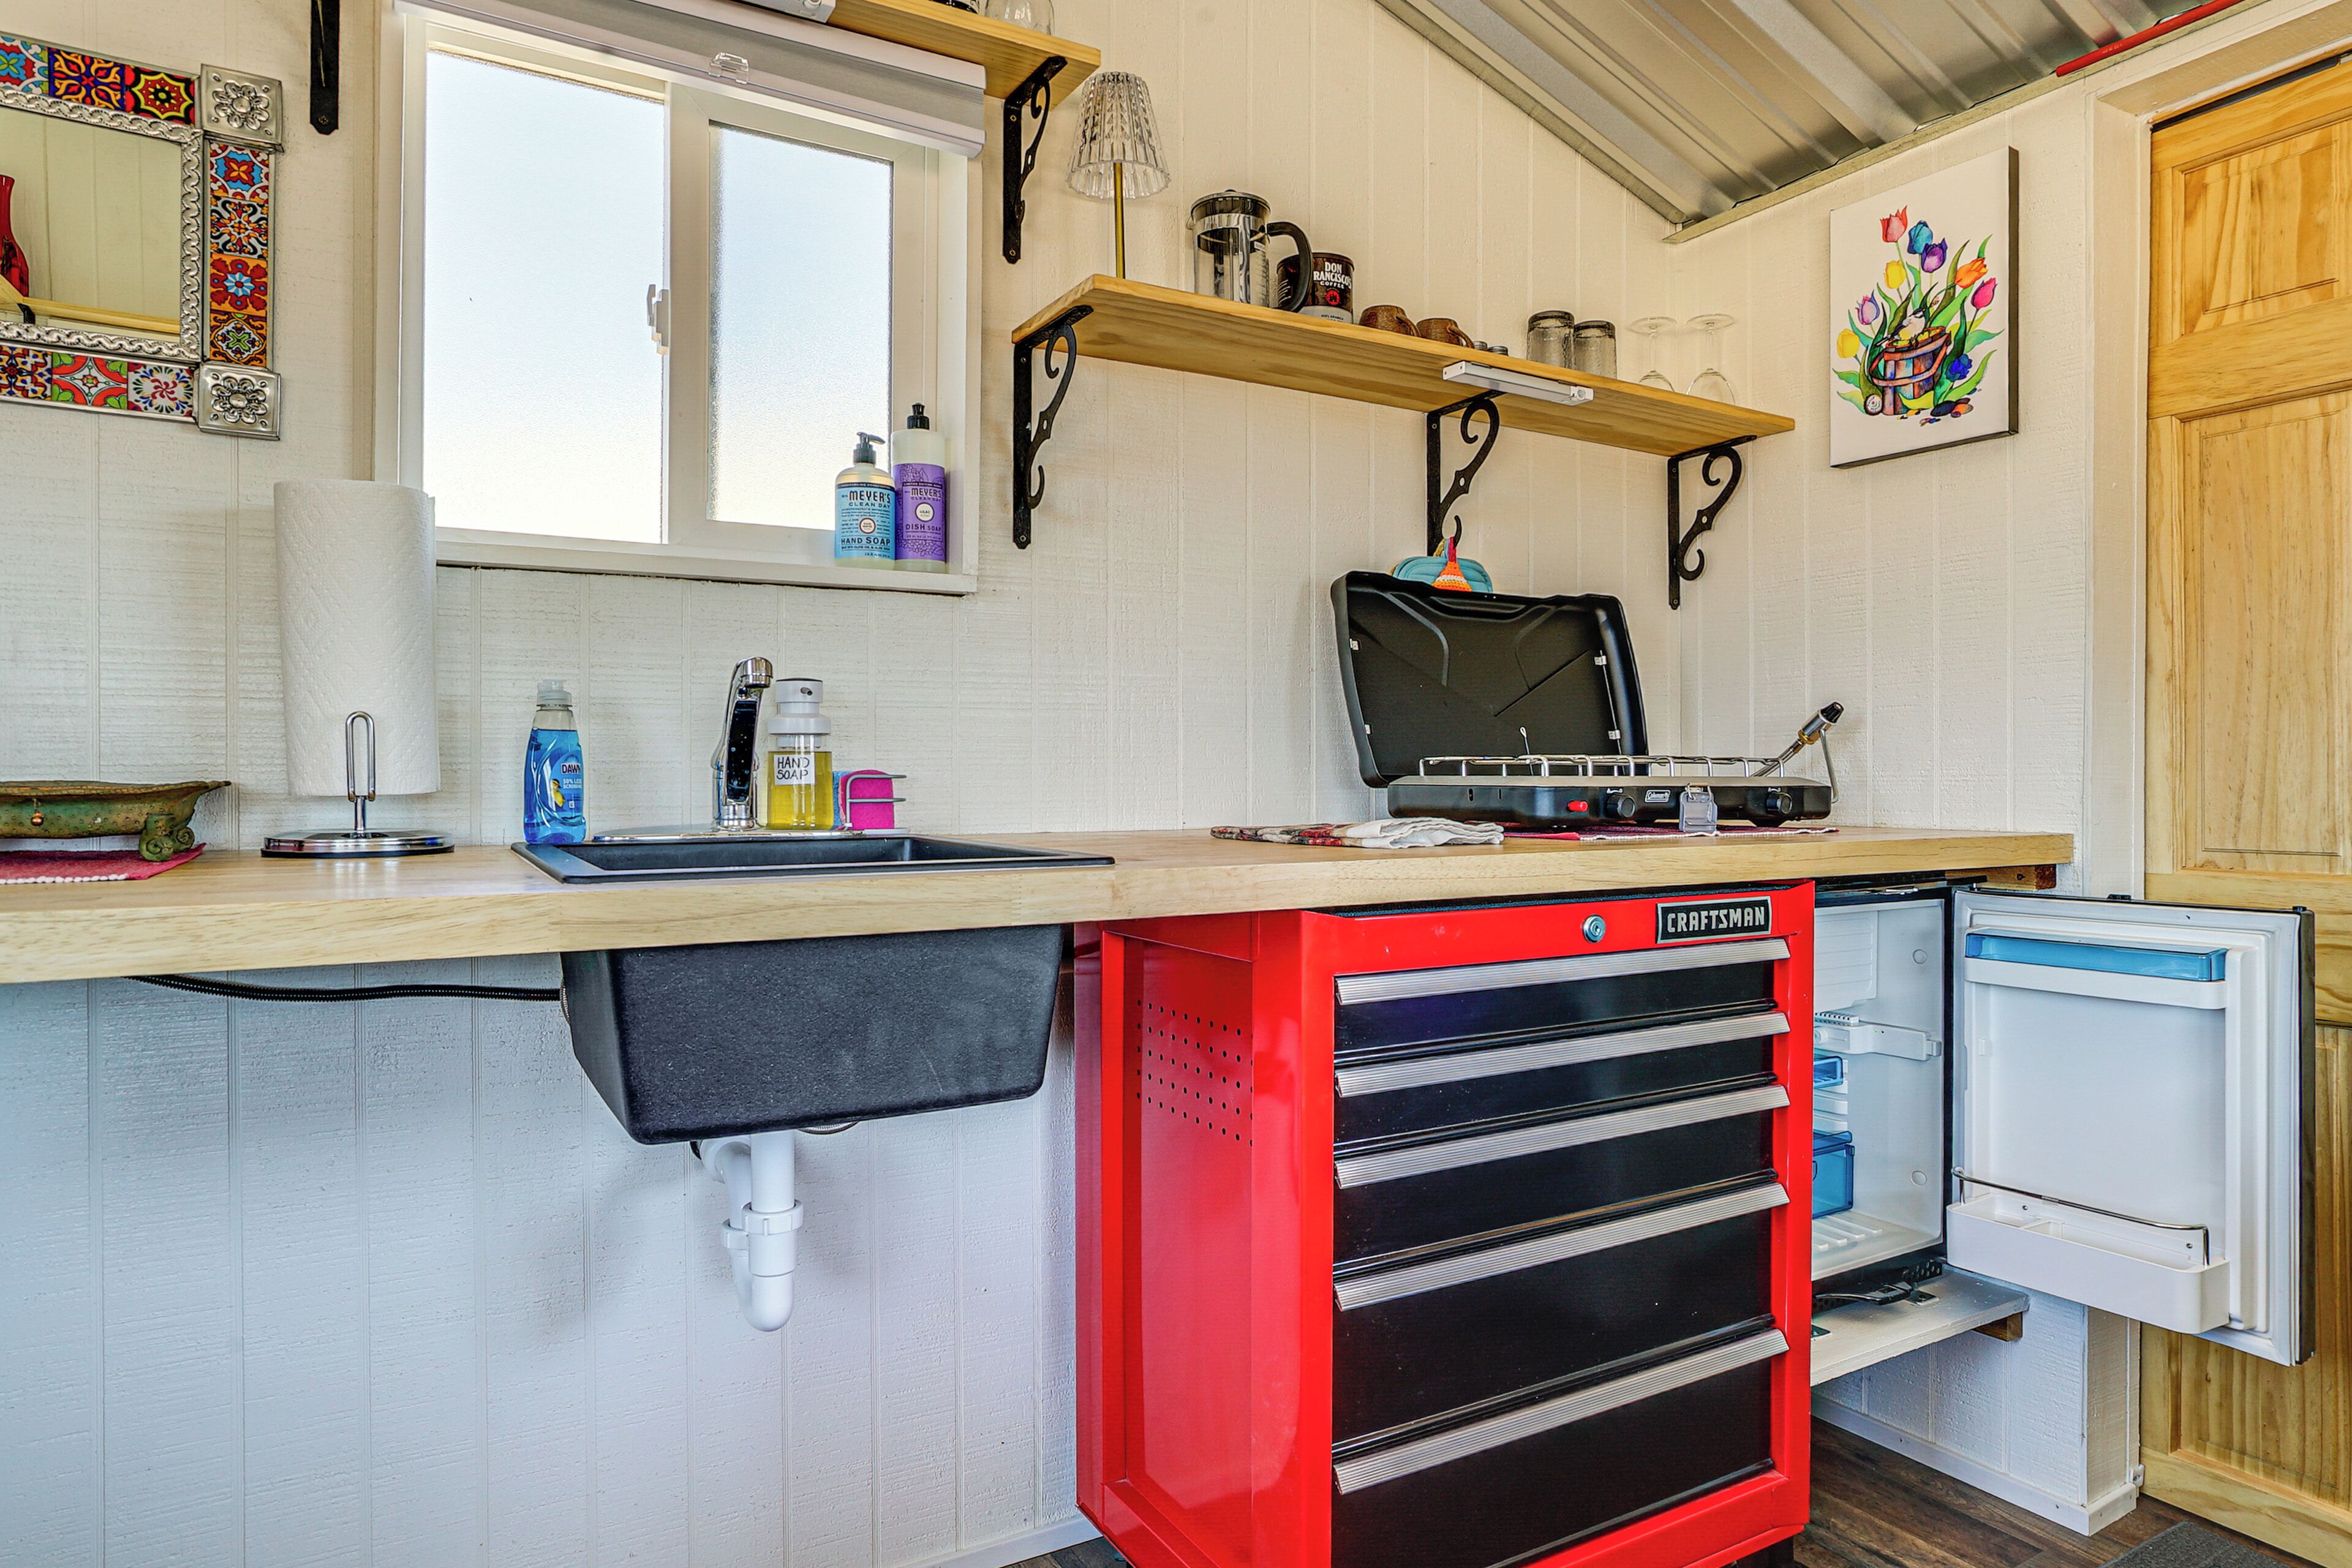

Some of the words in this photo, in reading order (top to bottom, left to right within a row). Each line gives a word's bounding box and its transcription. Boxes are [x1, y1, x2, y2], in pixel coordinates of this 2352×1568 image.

[1325, 262, 1342, 274] DON
[1313, 271, 1352, 289] RANCISCO'S
[849, 491, 891, 503] MEYER'S
[911, 488, 941, 498] MEYER'S
[865, 537, 891, 546] SOAP
[778, 756, 810, 769] HAND
[562, 764, 581, 774] DAWN
[777, 769, 809, 780] SOAP
[1667, 907, 1765, 933] CRAFTSMAN
